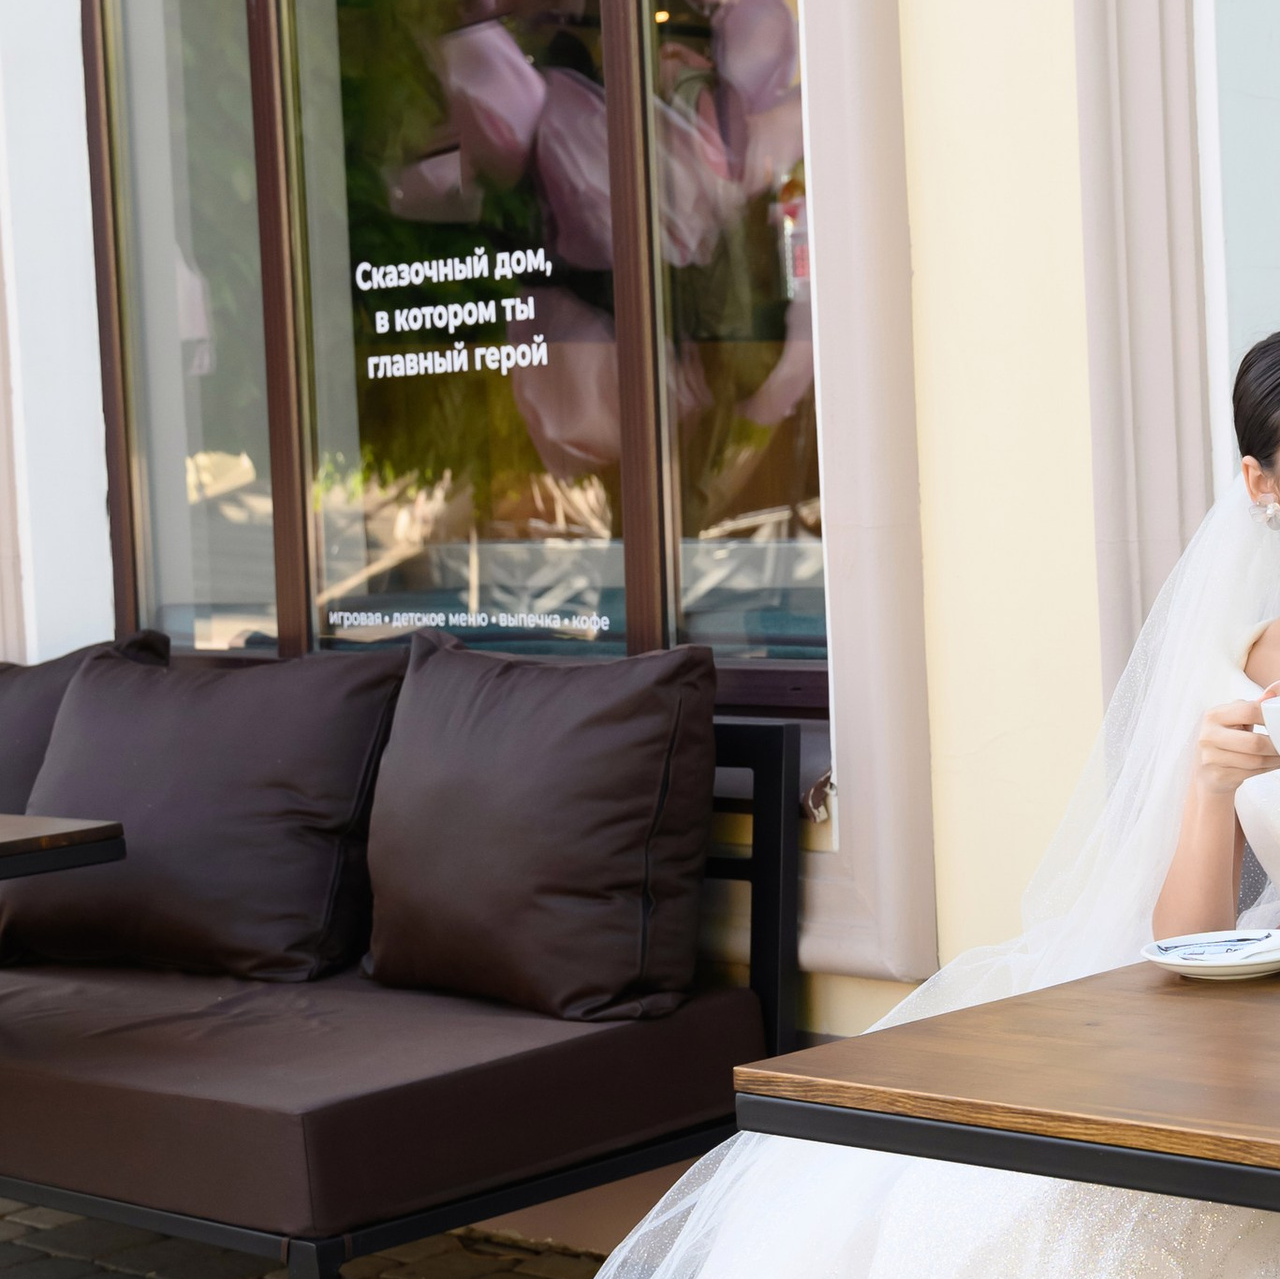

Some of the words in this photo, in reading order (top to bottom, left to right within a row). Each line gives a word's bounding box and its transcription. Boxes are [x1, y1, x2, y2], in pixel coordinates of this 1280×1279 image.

[354, 246, 489, 291] Сказочный
[494, 248, 552, 280] дом,
[375, 310, 389, 334] в
[395, 299, 496, 334] котором
[501, 296, 535, 321] ты
[367, 340, 468, 379] главный
[474, 334, 548, 376] герой
[329, 610, 382, 627] игровая
[392, 612, 446, 627] детское
[448, 612, 489, 626] меню
[499, 612, 561, 629] выпечка
[572, 611, 610, 631] кофе
